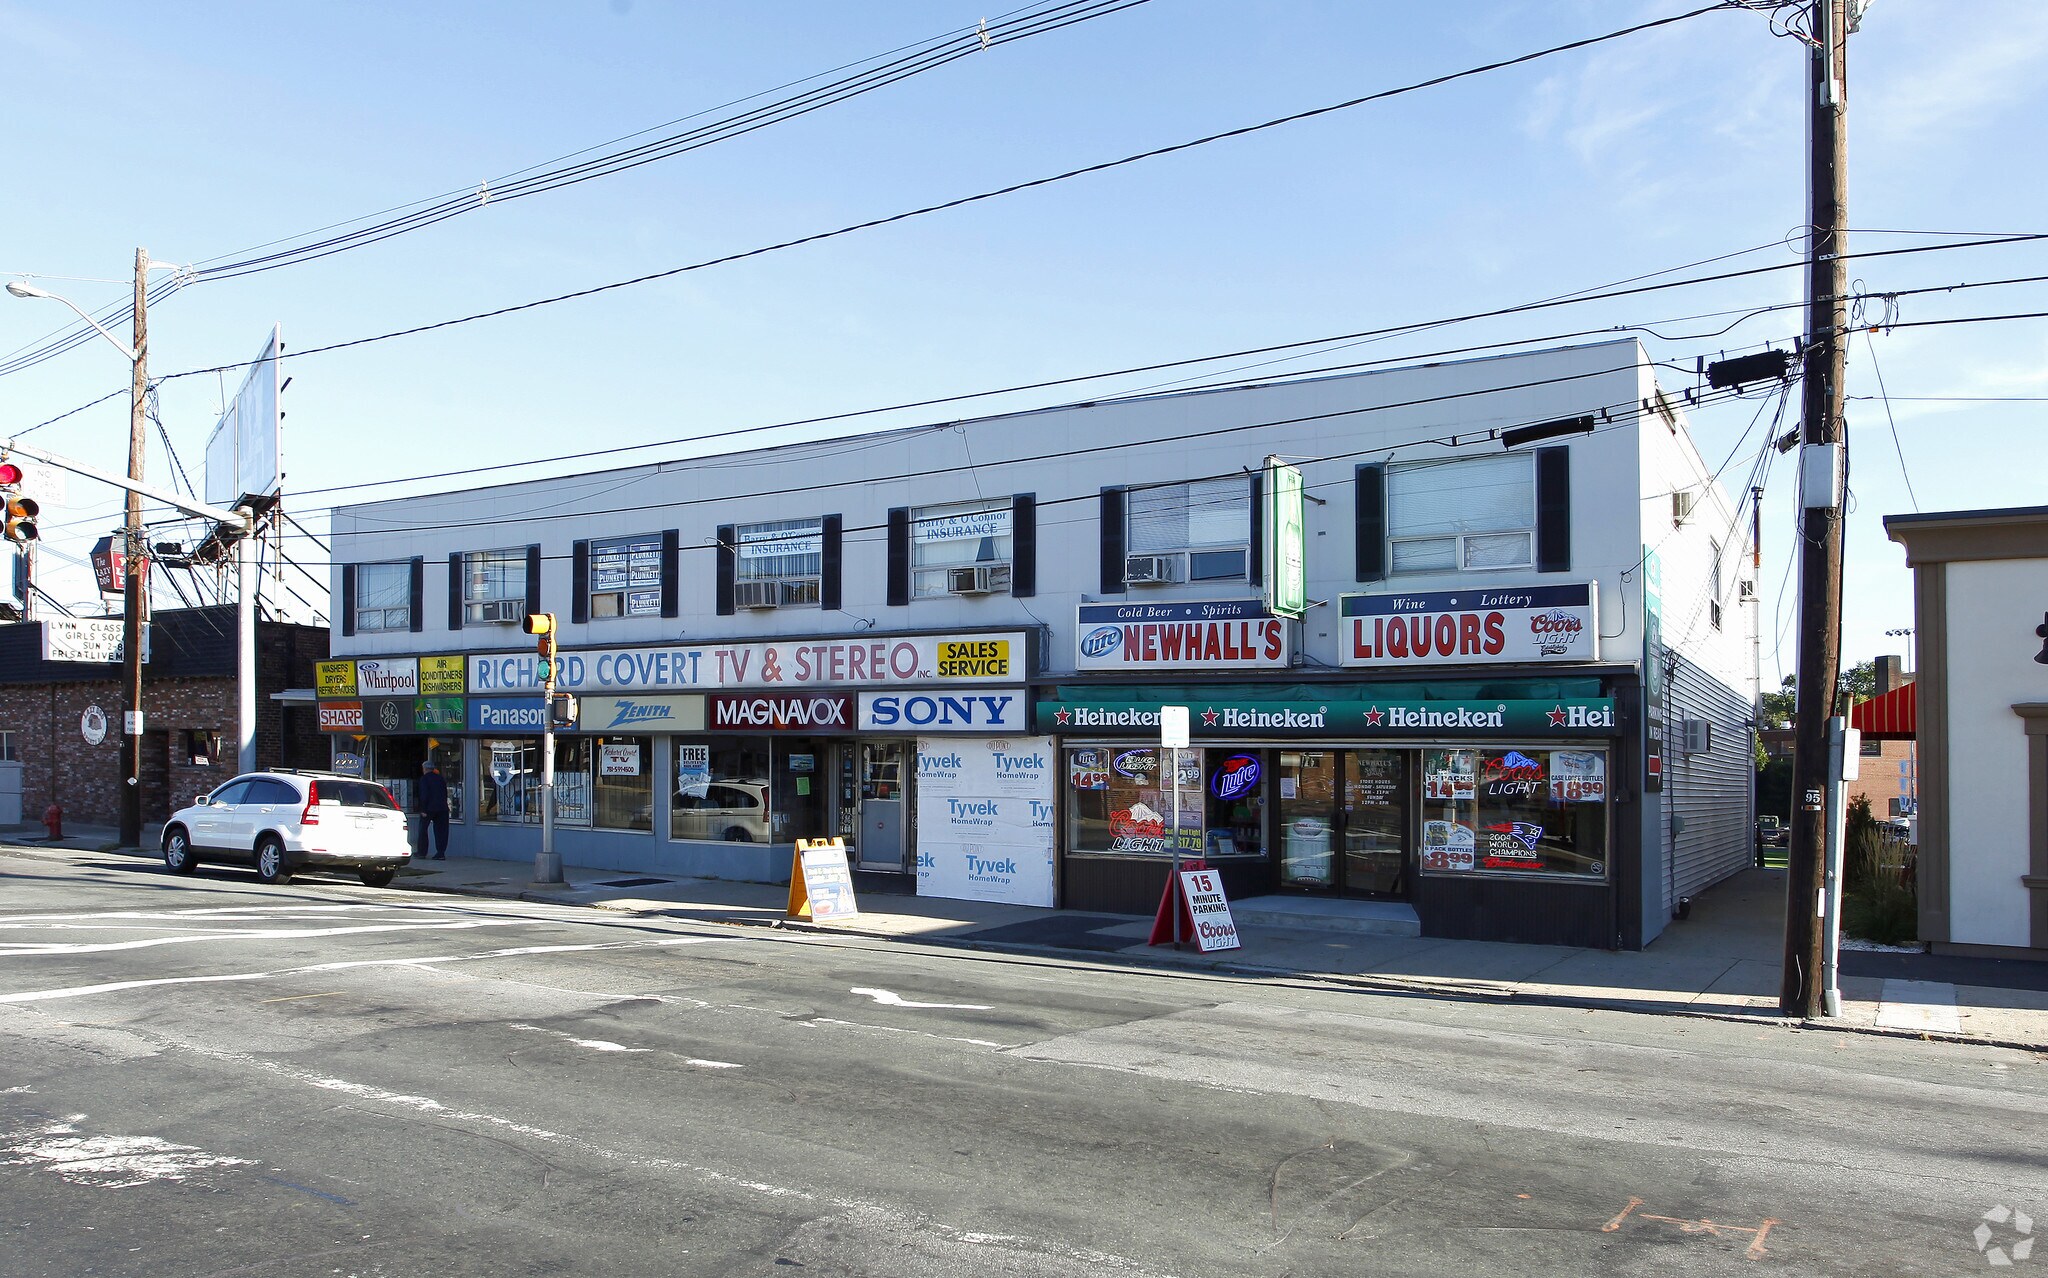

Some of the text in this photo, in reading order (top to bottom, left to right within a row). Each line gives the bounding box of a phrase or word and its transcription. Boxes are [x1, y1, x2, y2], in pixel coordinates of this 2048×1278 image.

[918, 510, 1007, 531] Barry & O'Connor
[926, 522, 998, 540] INSURANCE
[751, 540, 812, 555] INSURANCE
[96, 558, 106, 567] The
[96, 567, 111, 577] LAZY
[600, 574, 625, 583] PLUNKETT
[631, 570, 659, 580] PLUNKETT
[100, 575, 111, 586] DOG
[631, 598, 660, 608] PLUNKETT
[1392, 593, 1532, 610] Wine Lottery
[1117, 604, 1242, 619] Cold Beer Spirits
[51, 621, 77, 631] LYNN
[1530, 613, 1583, 634] Coors
[65, 632, 123, 641] GIRLS SOC
[1123, 619, 1282, 662] NEWHALL'S
[1353, 611, 1505, 659] LIQUORS
[1532, 632, 1580, 645] LIGHT
[83, 642, 101, 650] SUN
[947, 641, 998, 659] SALES
[1088, 630, 1118, 656] Lite
[322, 663, 349, 674] WASHERS
[436, 659, 447, 669] AIR
[596, 651, 702, 686] COVERT
[715, 641, 933, 683] TV & STEREO INC.
[938, 659, 1008, 676] SERVICE
[325, 674, 347, 684] DRYERS
[363, 669, 415, 692] Whirlpool
[421, 669, 464, 681] CONDITIONERS
[318, 685, 356, 695] REFRIGERATORS
[422, 681, 462, 692] DISHWASHERS
[320, 709, 363, 726] SHARP
[415, 708, 464, 724] MAYTAG
[480, 704, 564, 725] Panason
[606, 700, 676, 728] ZENITH
[716, 698, 845, 725] MAGNAVOX
[871, 696, 1012, 725] SONY
[1223, 707, 1326, 728] Heineken
[1388, 706, 1504, 728] Heineken
[1567, 705, 1615, 728] Hei
[683, 748, 707, 761] FREE
[992, 752, 1044, 772] Tyvek
[1080, 753, 1097, 764] Lite
[996, 771, 1039, 780] HomeWrap
[1484, 757, 1546, 781] Coors
[1220, 764, 1256, 797] Lite
[1488, 781, 1542, 795] LIGHT
[1805, 793, 1821, 804] 95
[947, 799, 999, 818] Tyvek
[951, 817, 993, 827] HomeWrap
[1109, 809, 1165, 839] Coors
[1111, 836, 1165, 851] LIGHT
[1489, 833, 1511, 841] 2004
[1489, 840, 1518, 849] WORLD
[1489, 848, 1538, 857] CHAMPIONS
[965, 854, 1017, 876] Tyvek
[968, 873, 1011, 885] HomeWrap
[1191, 874, 1213, 893] 15
[1192, 893, 1222, 904] MINUTE
[1192, 903, 1227, 914] PARKING
[1198, 921, 1236, 939] Coors
[1206, 936, 1235, 949] LIGHT
